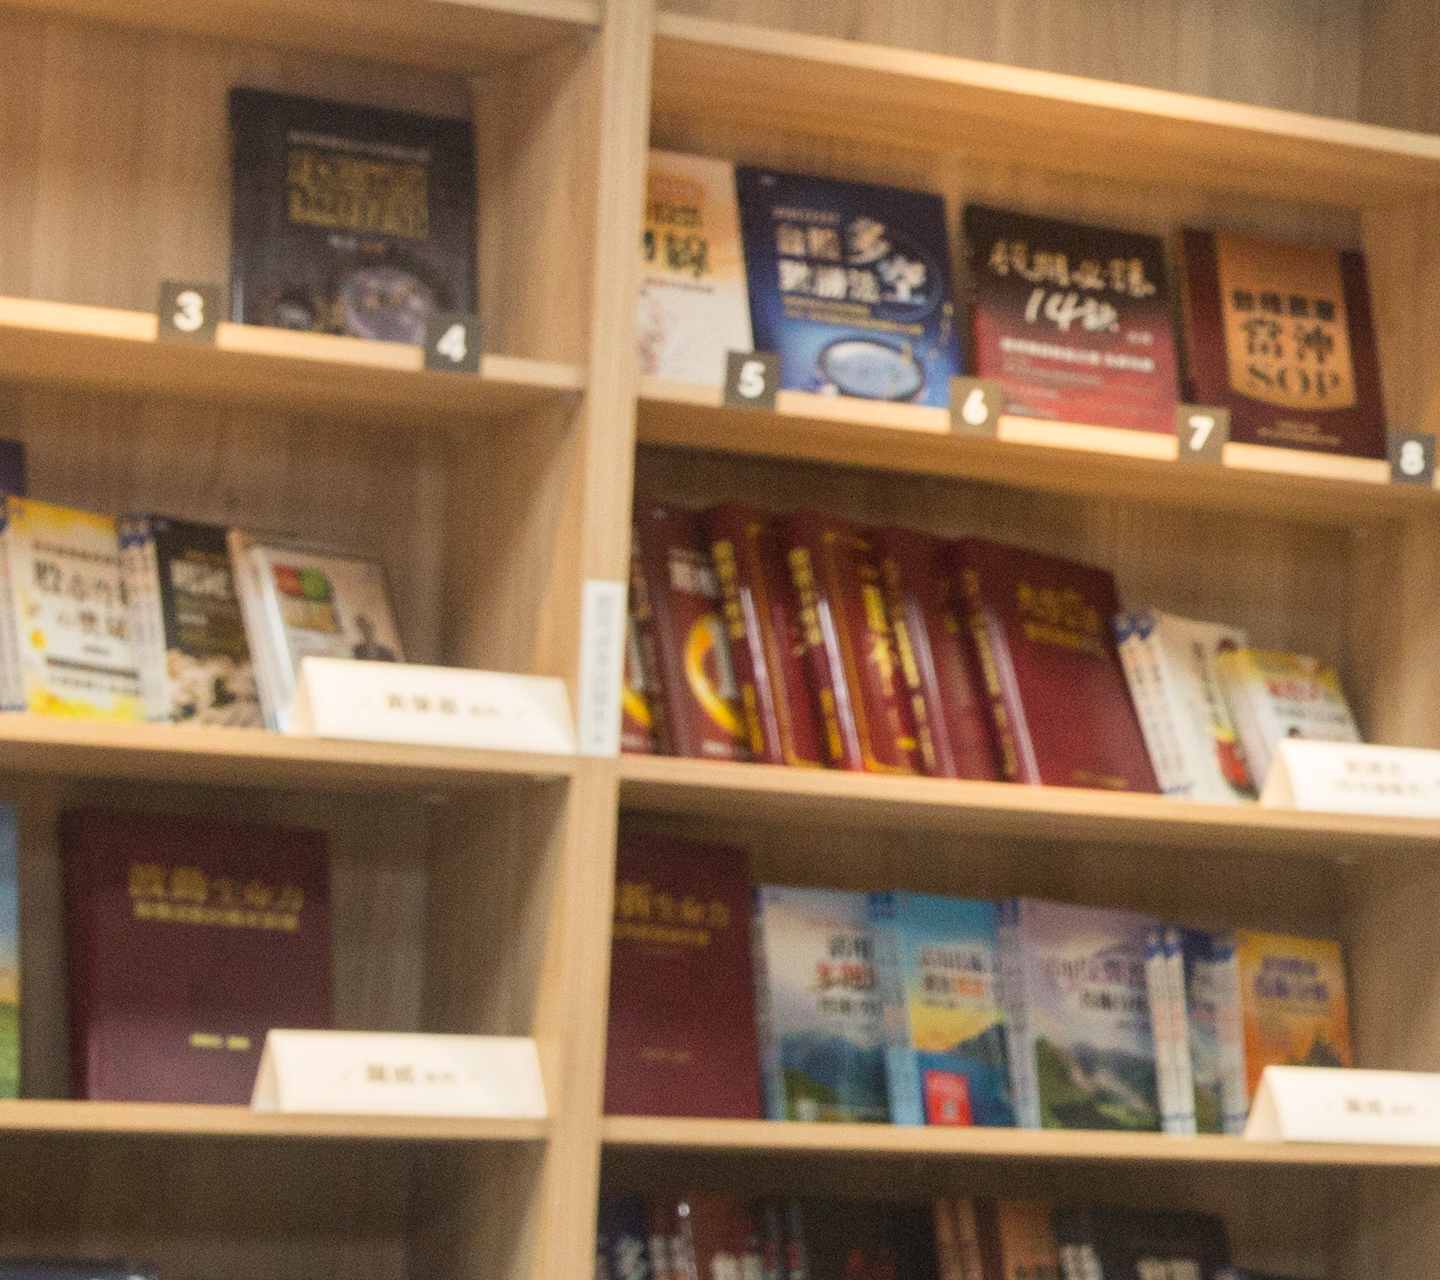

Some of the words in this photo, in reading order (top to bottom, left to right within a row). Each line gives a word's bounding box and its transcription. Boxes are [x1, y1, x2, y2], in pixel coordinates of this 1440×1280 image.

[174, 291, 203, 332] 3
[437, 325, 466, 362] 4
[739, 361, 765, 398] 5
[1246, 366, 1341, 398] SOP
[962, 389, 988, 425] 6
[1188, 415, 1215, 451] 7
[1400, 441, 1424, 476] 8
